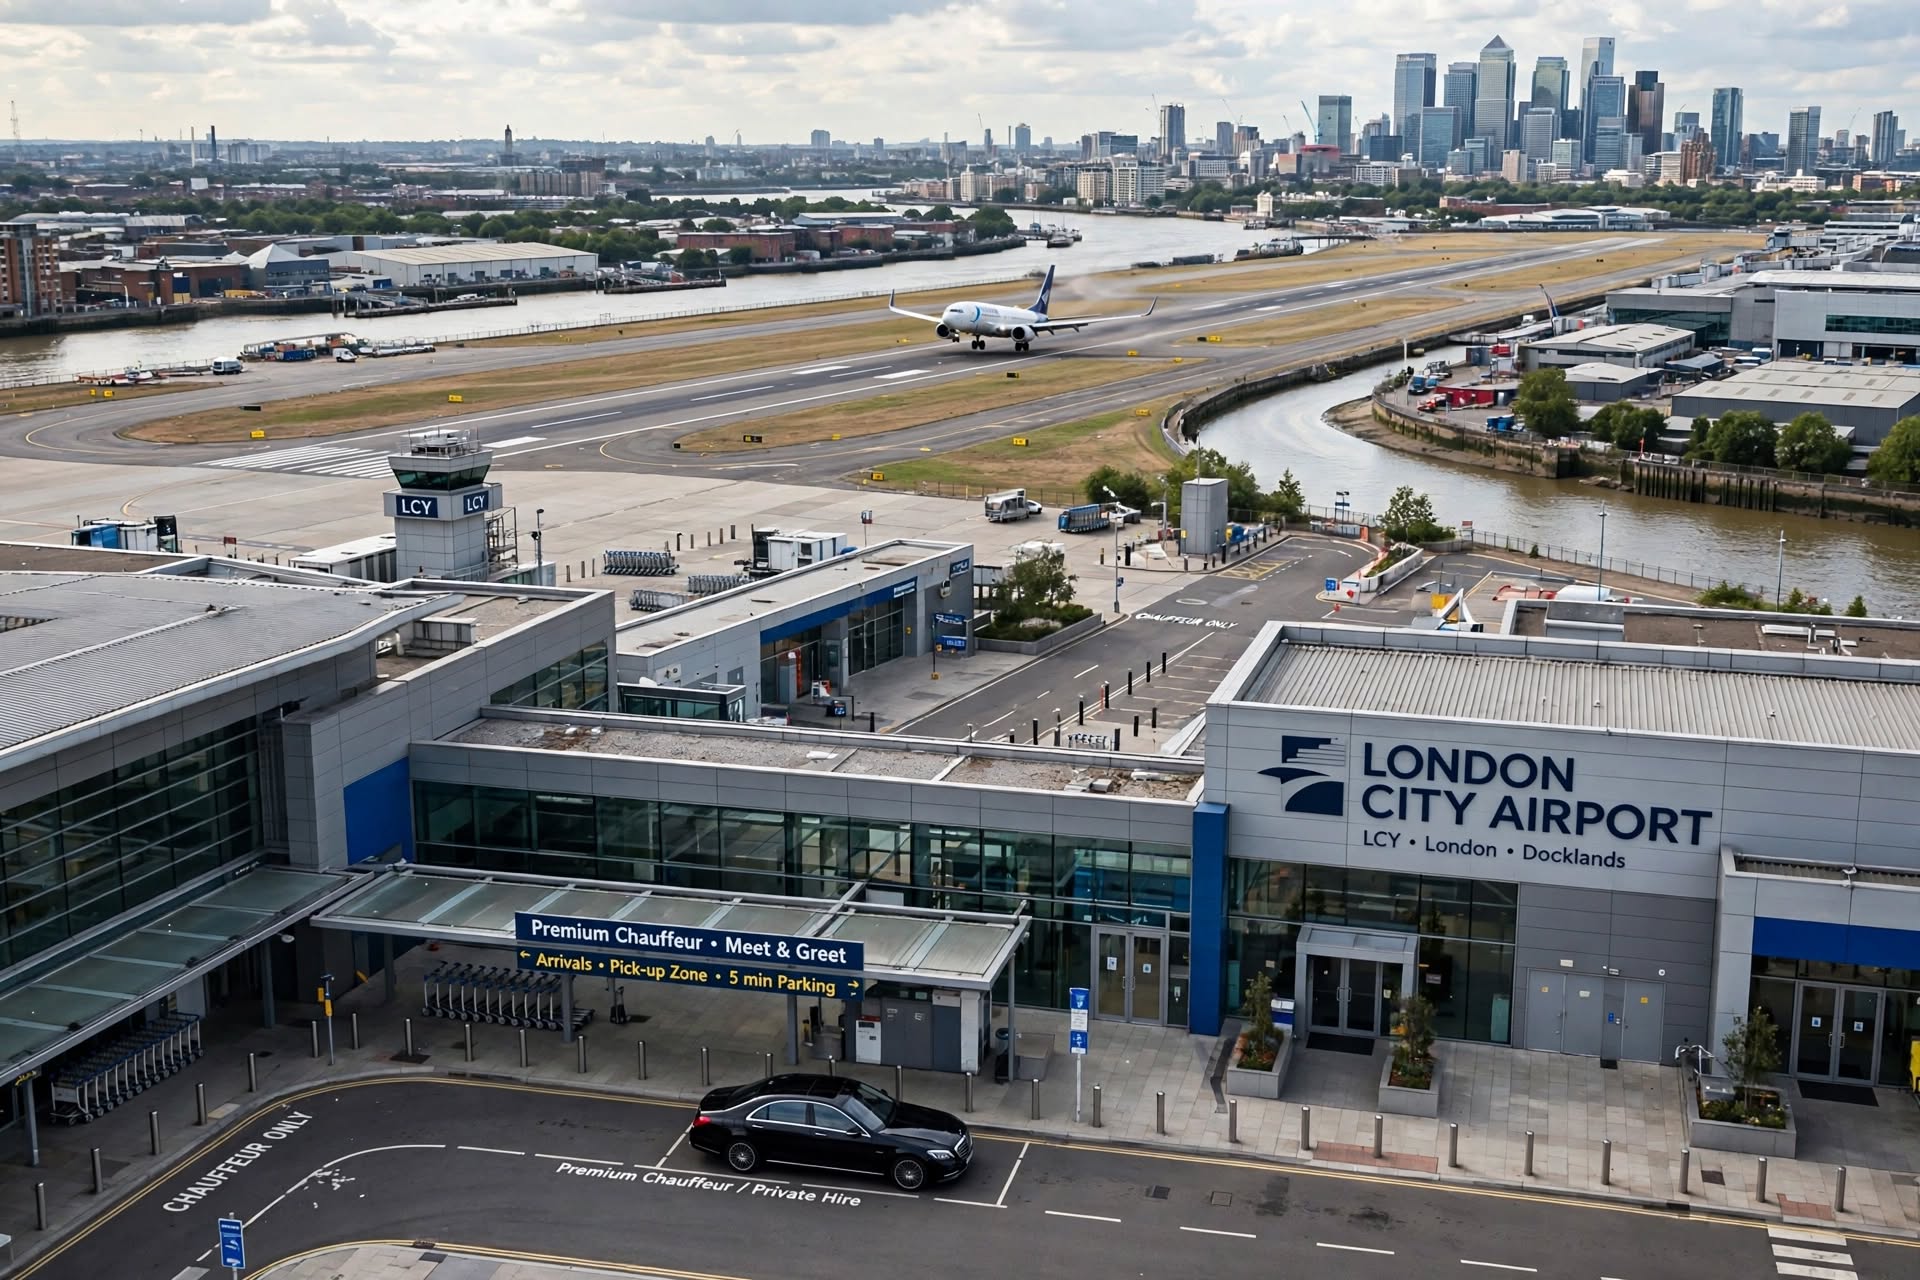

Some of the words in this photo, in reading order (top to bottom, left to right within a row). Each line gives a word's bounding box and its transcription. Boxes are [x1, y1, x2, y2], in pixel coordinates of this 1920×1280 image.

[402, 498, 431, 515] LCY
[467, 495, 485, 512] LCY
[1205, 619, 1239, 629] ONLY
[1364, 742, 1574, 792] LONDON
[1362, 784, 1477, 826] CITY
[1489, 796, 1713, 846] AIRPORT
[1364, 829, 1401, 848] LCY
[1426, 836, 1497, 857] London
[1523, 844, 1625, 869] Docklands
[532, 919, 609, 942] Premium
[616, 926, 703, 950] Chauffeur
[726, 937, 772, 957] Meet
[777, 942, 791, 958] &
[797, 943, 847, 964] Greet
[536, 953, 592, 972] Arrivals
[610, 959, 665, 982] Pick-up
[670, 964, 708, 983] Zone
[729, 970, 738, 985] 5
[743, 973, 773, 988] min
[778, 975, 836, 998] Parking
[163, 1143, 273, 1212] CHAUFFEUR
[263, 1111, 313, 1140] ONLY
[556, 1162, 638, 1182] Premium
[643, 1172, 734, 1192] Chauffeur
[752, 1183, 817, 1202] Private
[822, 1192, 861, 1207] Hire
